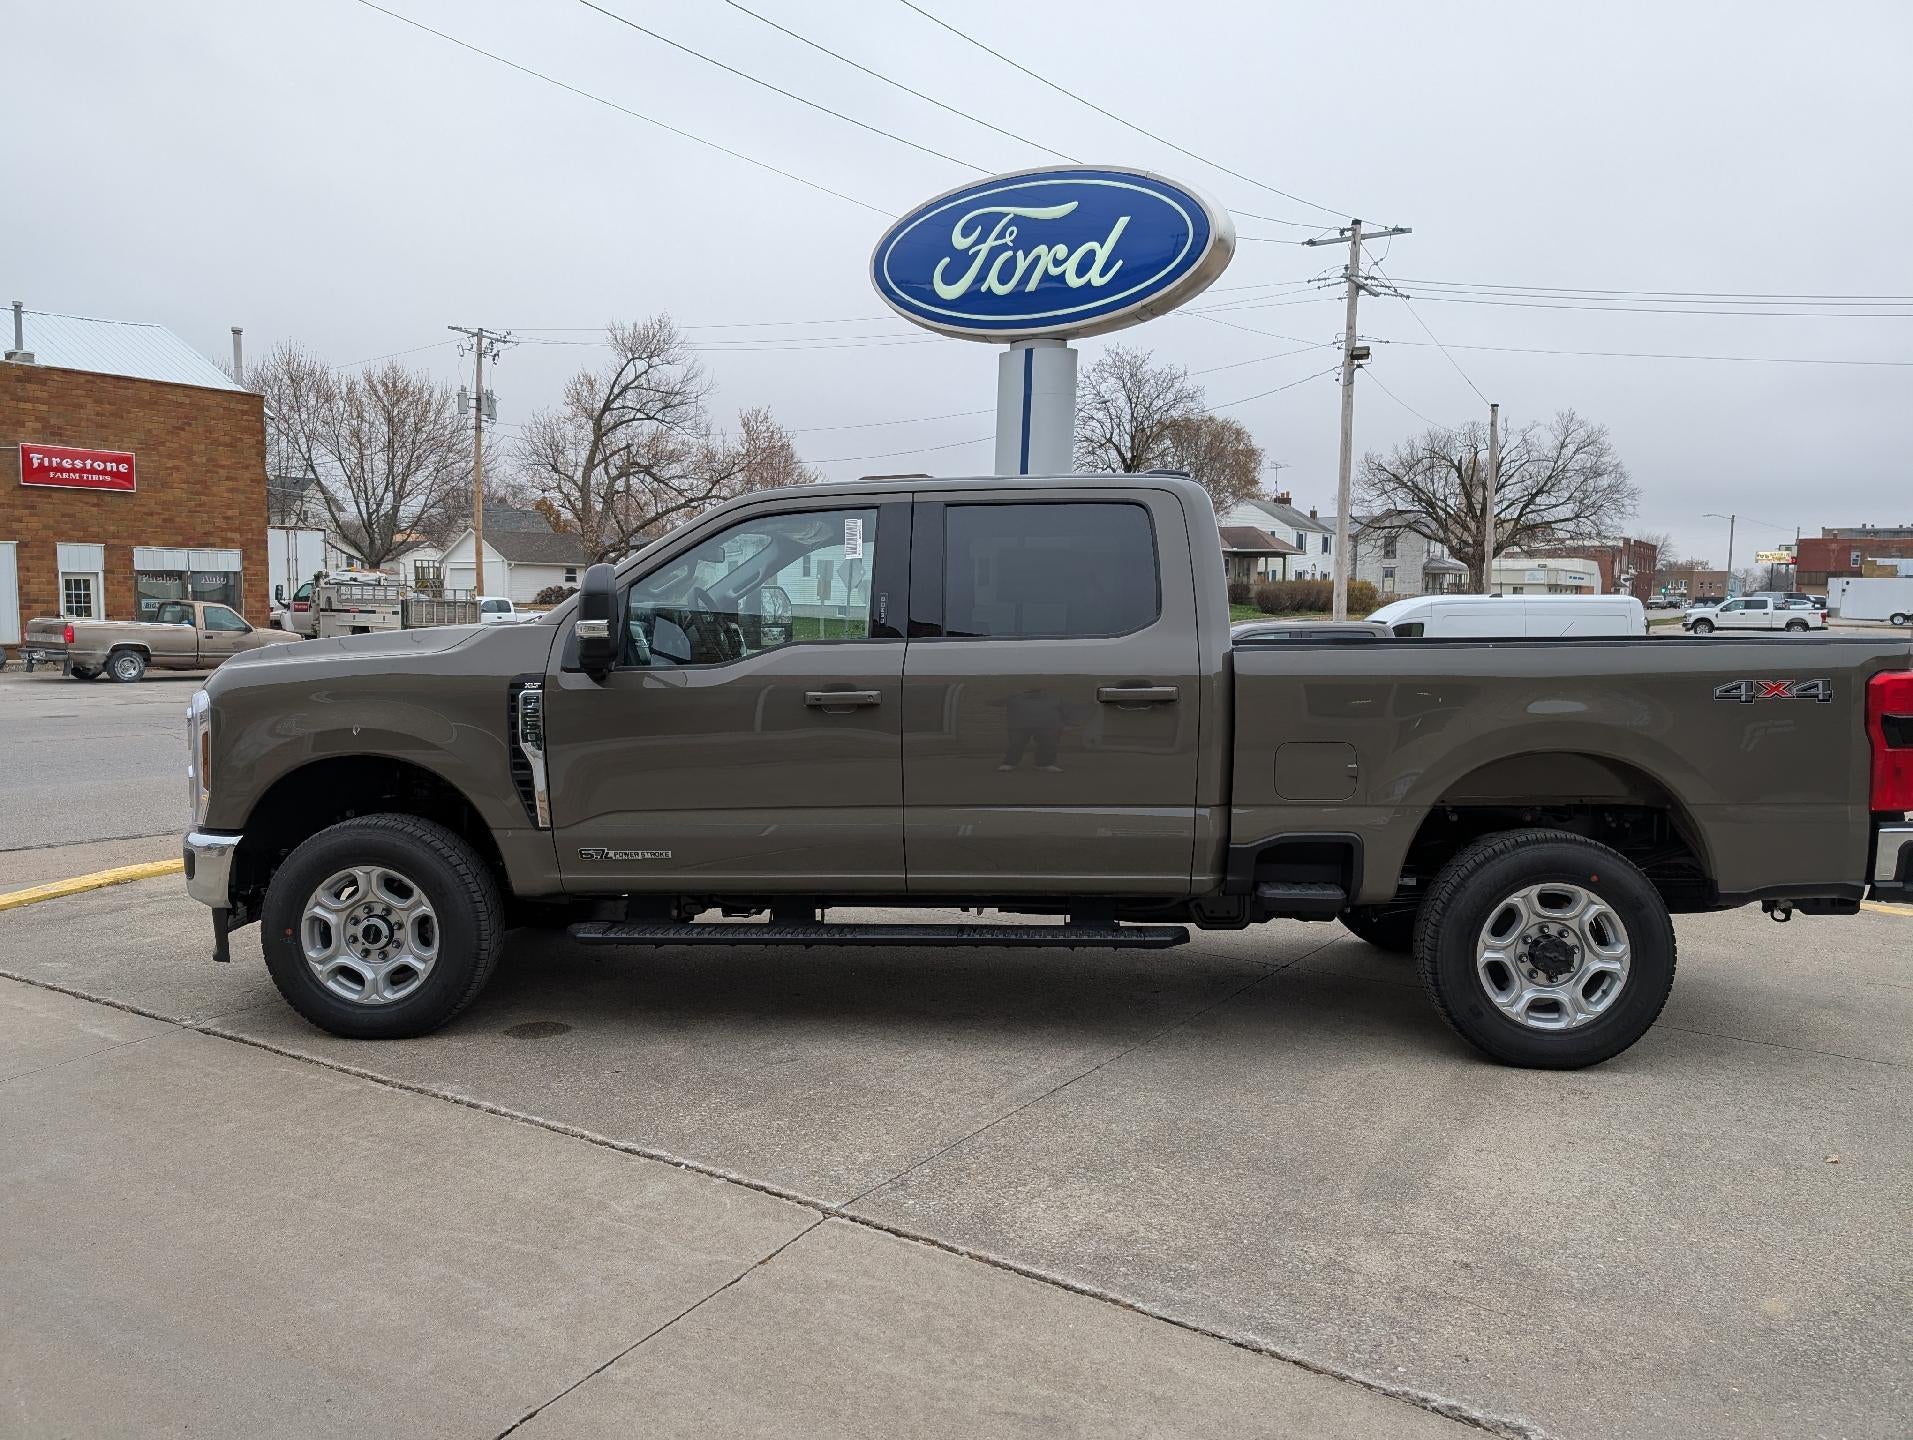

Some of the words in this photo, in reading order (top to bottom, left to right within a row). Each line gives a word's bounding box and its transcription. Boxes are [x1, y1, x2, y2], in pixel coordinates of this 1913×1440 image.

[933, 201, 1131, 299] Ford
[29, 453, 129, 473] Firestone
[49, 472, 80, 480] FARM
[613, 851, 640, 860] POWER
[641, 850, 671, 859] STROKE
